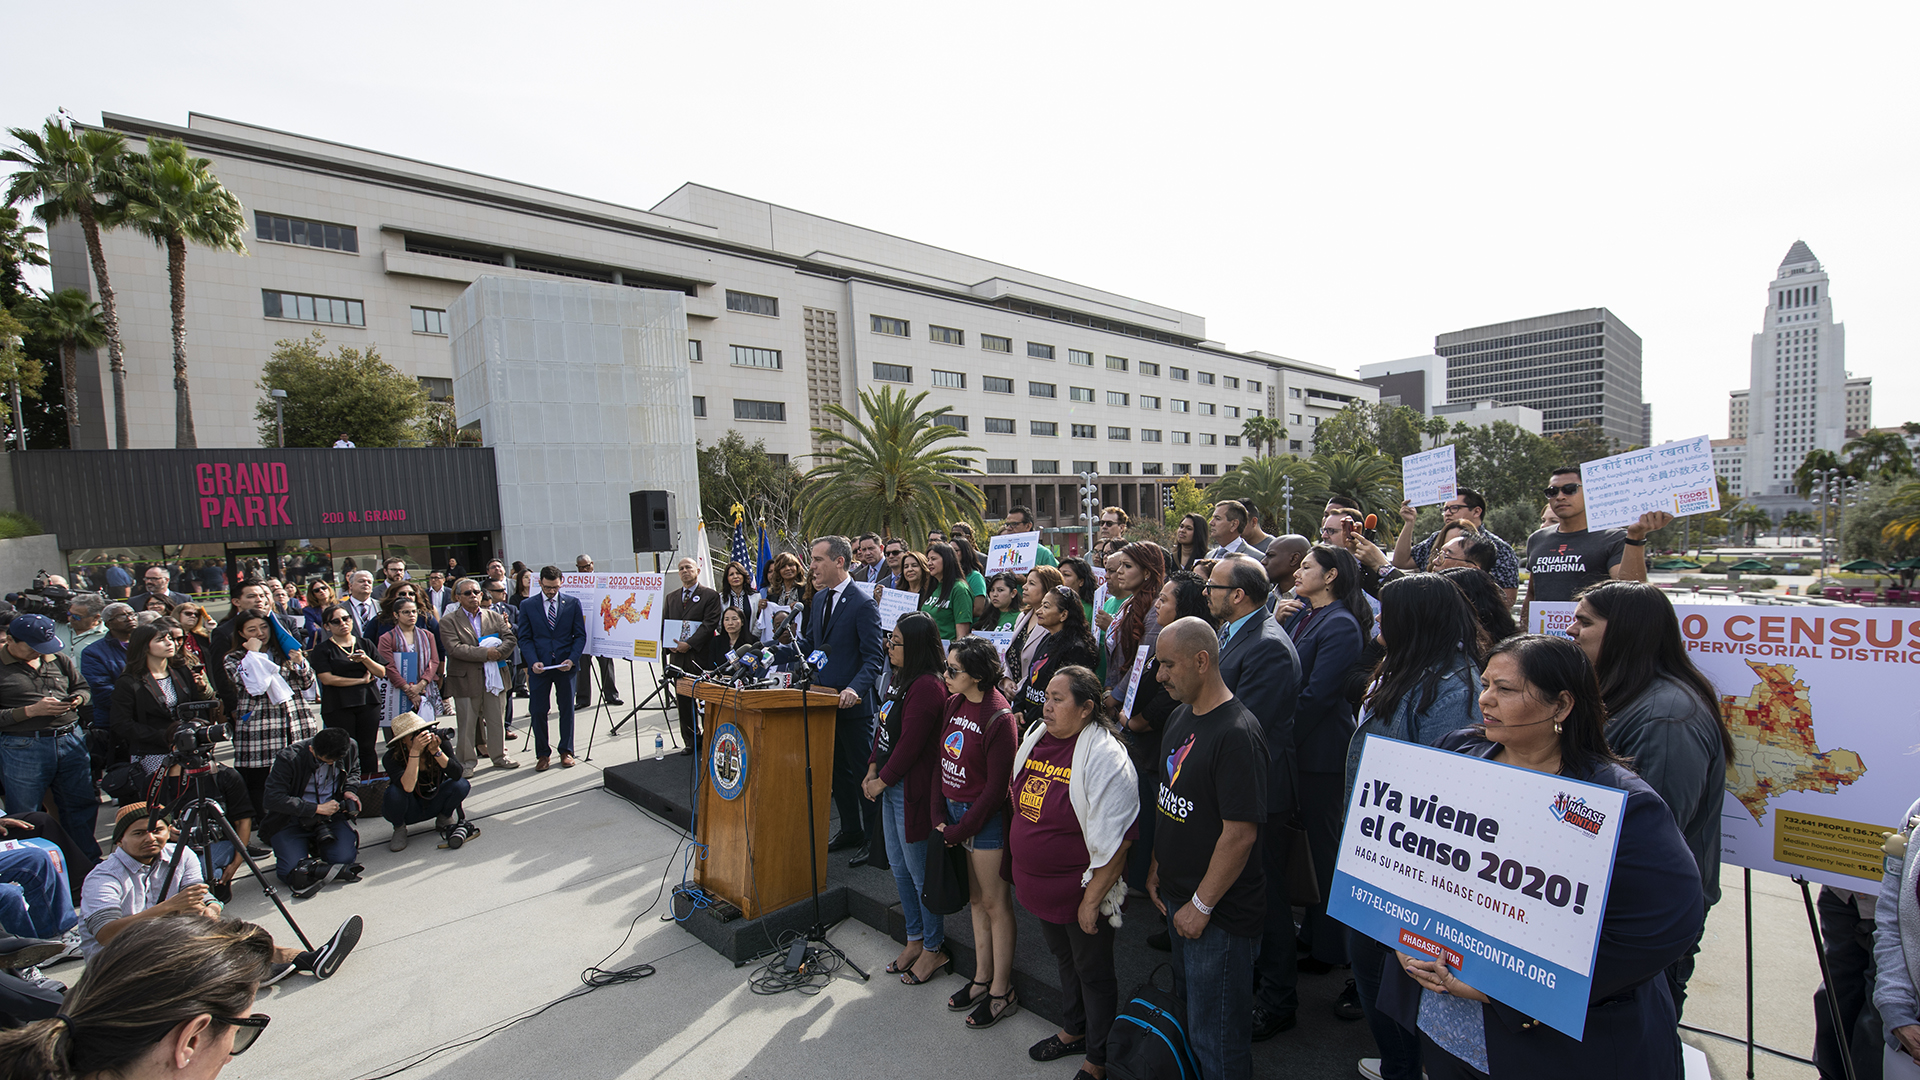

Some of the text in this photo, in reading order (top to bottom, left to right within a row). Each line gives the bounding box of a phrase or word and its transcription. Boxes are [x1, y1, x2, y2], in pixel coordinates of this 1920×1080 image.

[196, 462, 289, 496] GRAND
[1648, 461, 1710, 482] 全員が数える
[1679, 490, 1708, 499] TODOS
[1679, 496, 1708, 504] CUENTAN
[200, 495, 293, 528] PARK
[322, 509, 406, 524] 200 N. GRAND
[1680, 504, 1710, 513] COUNTS
[1532, 563, 1586, 573] CALIFORNIA
[1536, 555, 1582, 565] EQUALITY
[609, 576, 628, 585] 2020
[629, 576, 662, 586] CENSUS
[1685, 641, 1822, 659] PERVISORIAL
[941, 758, 966, 779] CHIRLA
[1359, 779, 1499, 843] ¡Ya viene
[1568, 800, 1605, 825] HÁGASE
[1565, 811, 1600, 834] CONTAR
[1784, 816, 1816, 827] 732,641
[1818, 822, 1851, 833] PEOPLE
[1783, 824, 1835, 838] hard-to-survey
[1837, 833, 1865, 844] Census
[1783, 837, 1881, 860] Median household income:
[1360, 815, 1589, 915] el Censo 2020!
[1783, 850, 1804, 859] Below
[1806, 855, 1834, 866] poverty
[1836, 860, 1856, 868] level:
[1858, 864, 1883, 874] 15.4%
[1355, 846, 1529, 925] HAGA SU PARTE. HÁGASE CONTAR.
[1351, 885, 1420, 926] 1-877-EL-CENSO
[1435, 920, 1557, 990] HAGASECONTAR.ORG
